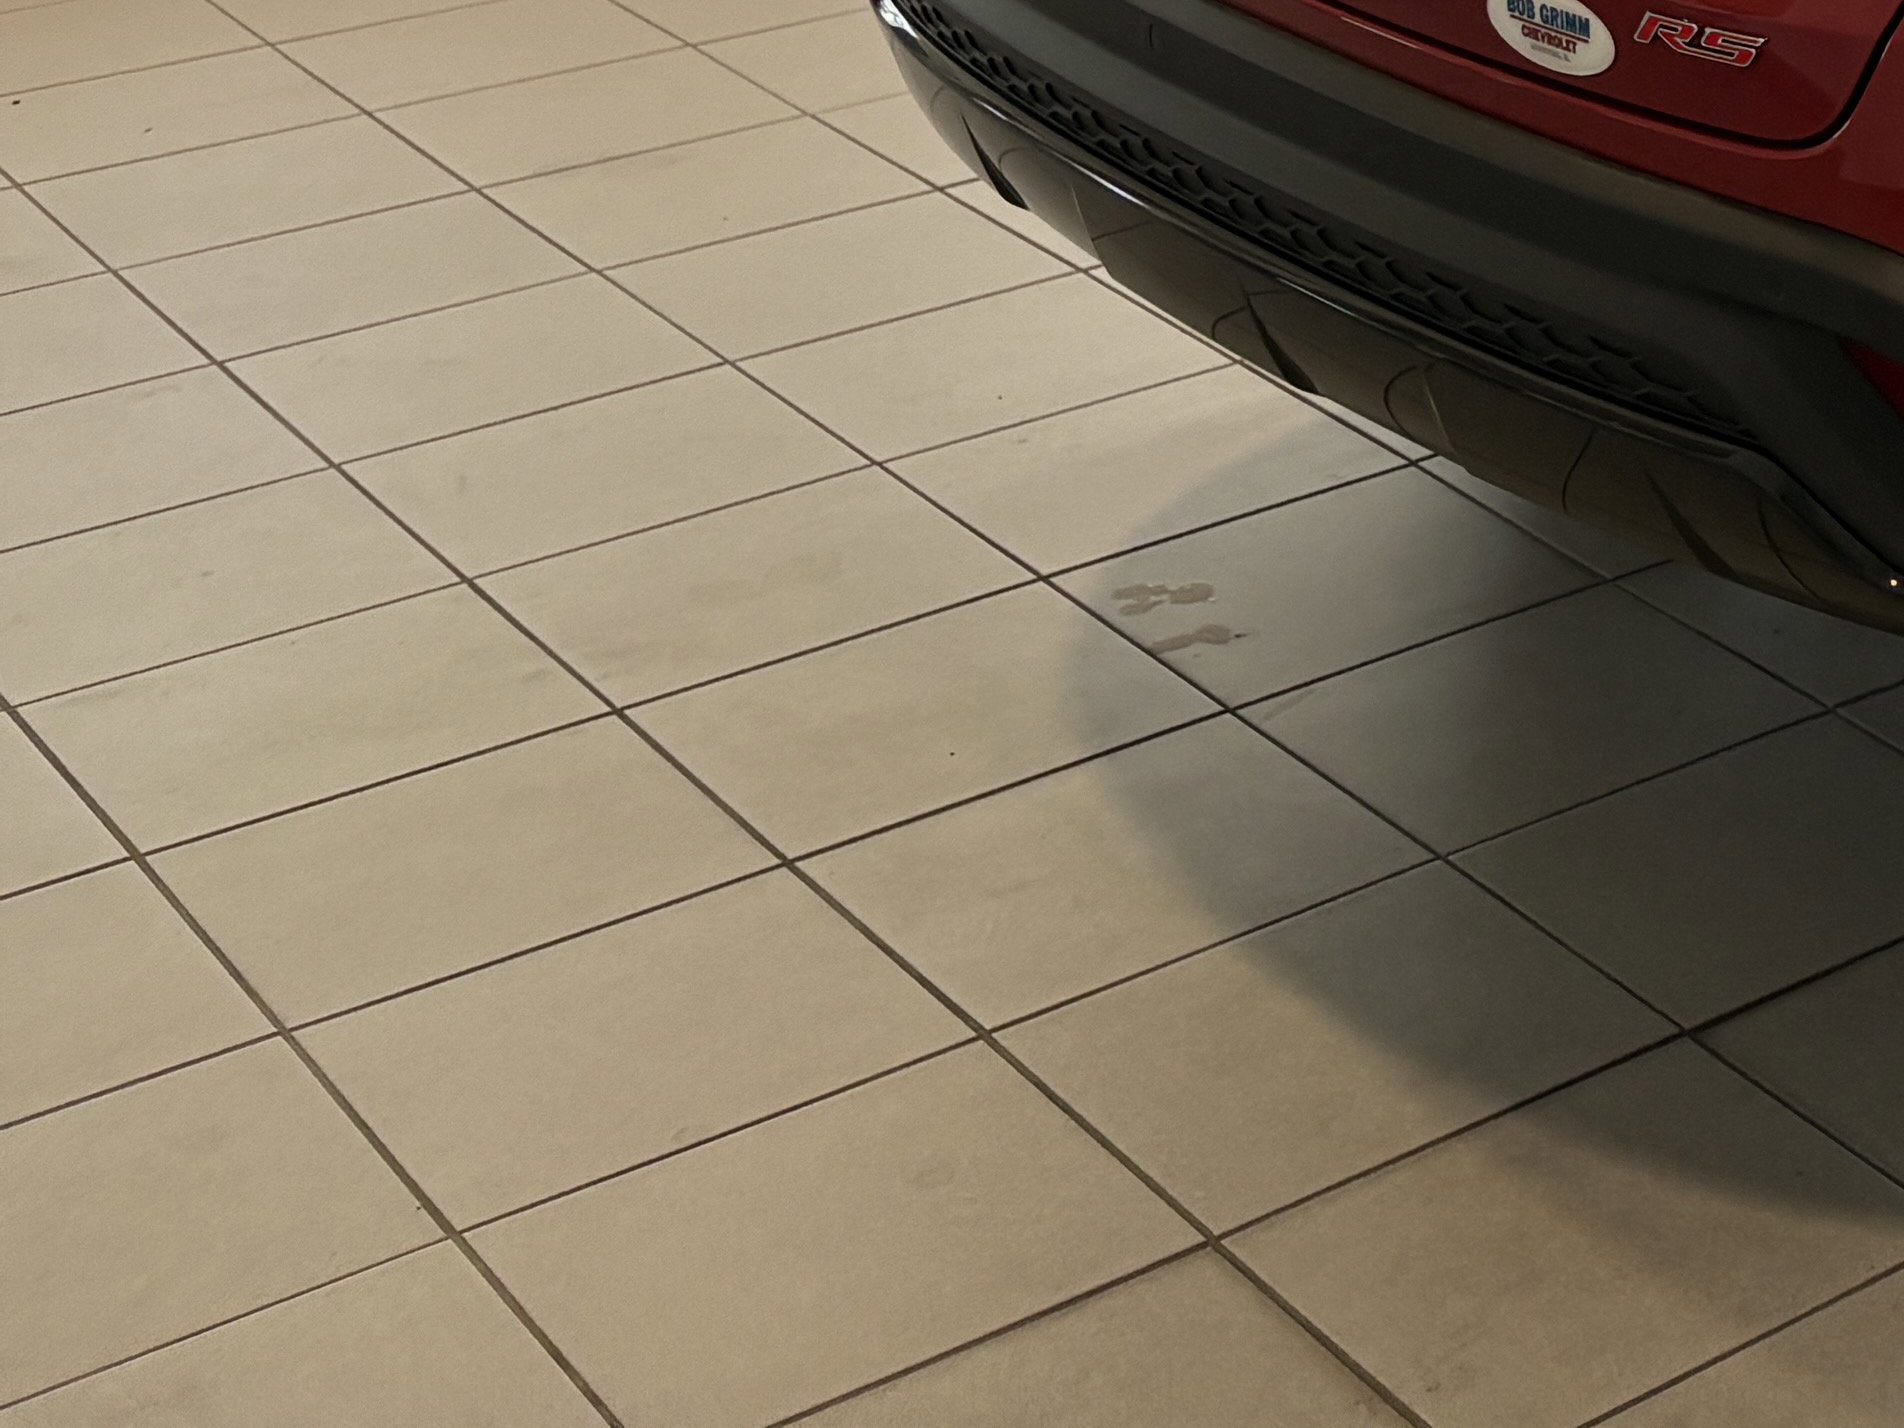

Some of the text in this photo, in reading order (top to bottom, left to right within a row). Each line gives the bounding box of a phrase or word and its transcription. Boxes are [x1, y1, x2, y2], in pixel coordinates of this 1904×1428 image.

[1520, 23, 1578, 55] CHEVROLET
[1539, 3, 1591, 39] GRIMM
[1633, 10, 1768, 68] RS
